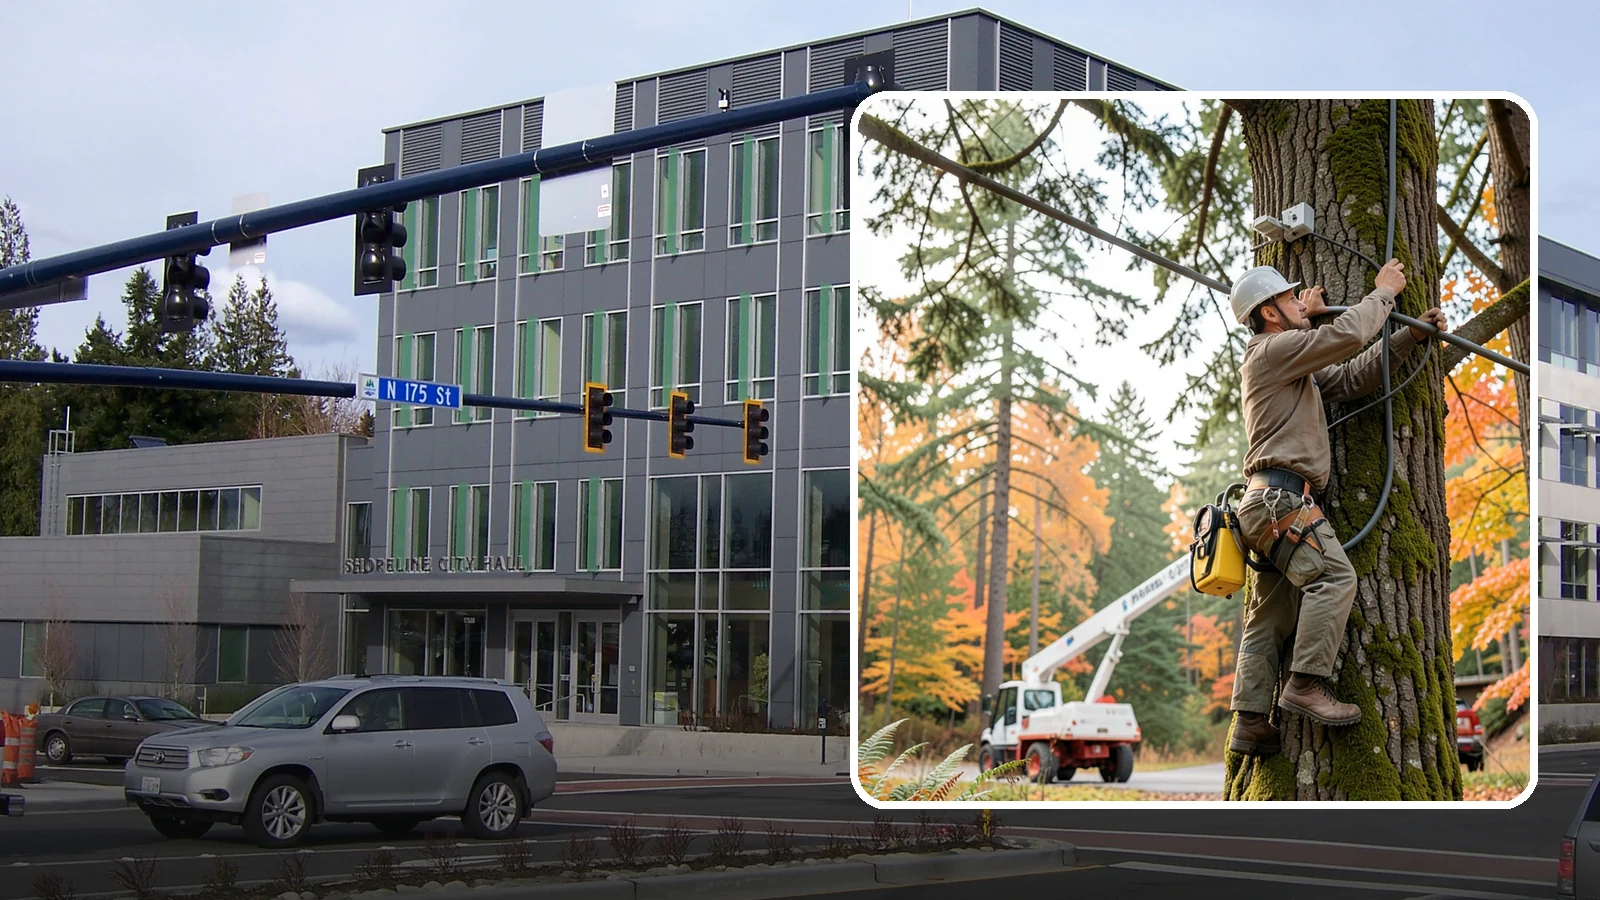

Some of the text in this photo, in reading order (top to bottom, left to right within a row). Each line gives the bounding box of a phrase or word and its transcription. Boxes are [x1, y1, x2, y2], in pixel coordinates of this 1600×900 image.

[387, 380, 451, 406] N 175 St
[344, 555, 525, 574] SHORELINE CITY HALL
